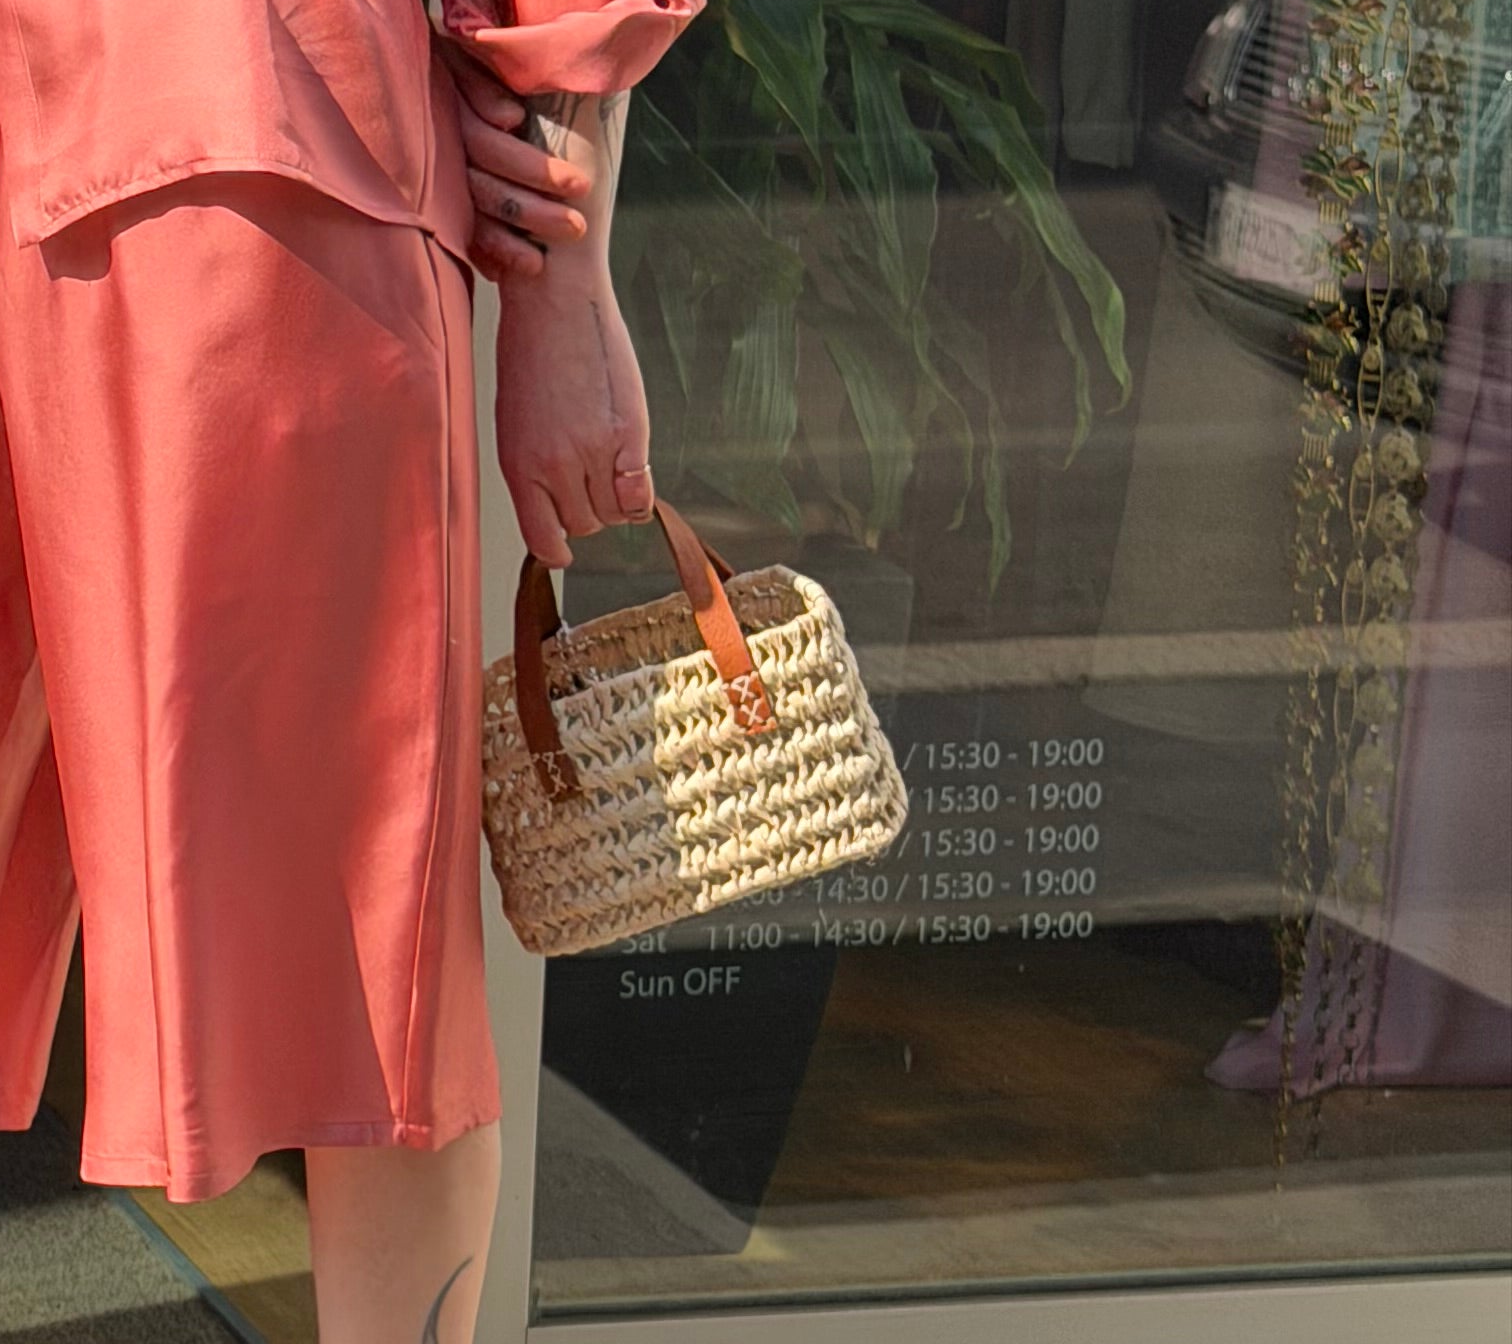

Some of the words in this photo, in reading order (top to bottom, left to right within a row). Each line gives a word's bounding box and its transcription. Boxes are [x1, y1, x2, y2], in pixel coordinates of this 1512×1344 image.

[925, 741, 1000, 770] 15:30
[1029, 738, 1104, 768] 19:00
[923, 784, 999, 814] 15:30
[1027, 781, 1102, 811] 19:00
[921, 827, 996, 857] 15:30
[1024, 824, 1100, 854] 19:00
[813, 874, 889, 904] 14:30
[918, 871, 993, 900] 15:30
[1021, 867, 1096, 897] 19:00
[707, 922, 782, 951] 11:00
[811, 918, 886, 948] 14:30
[917, 914, 991, 944] 15:30
[1018, 910, 1093, 940] 19:00
[619, 970, 674, 999] Sun
[683, 966, 741, 996] OFF
